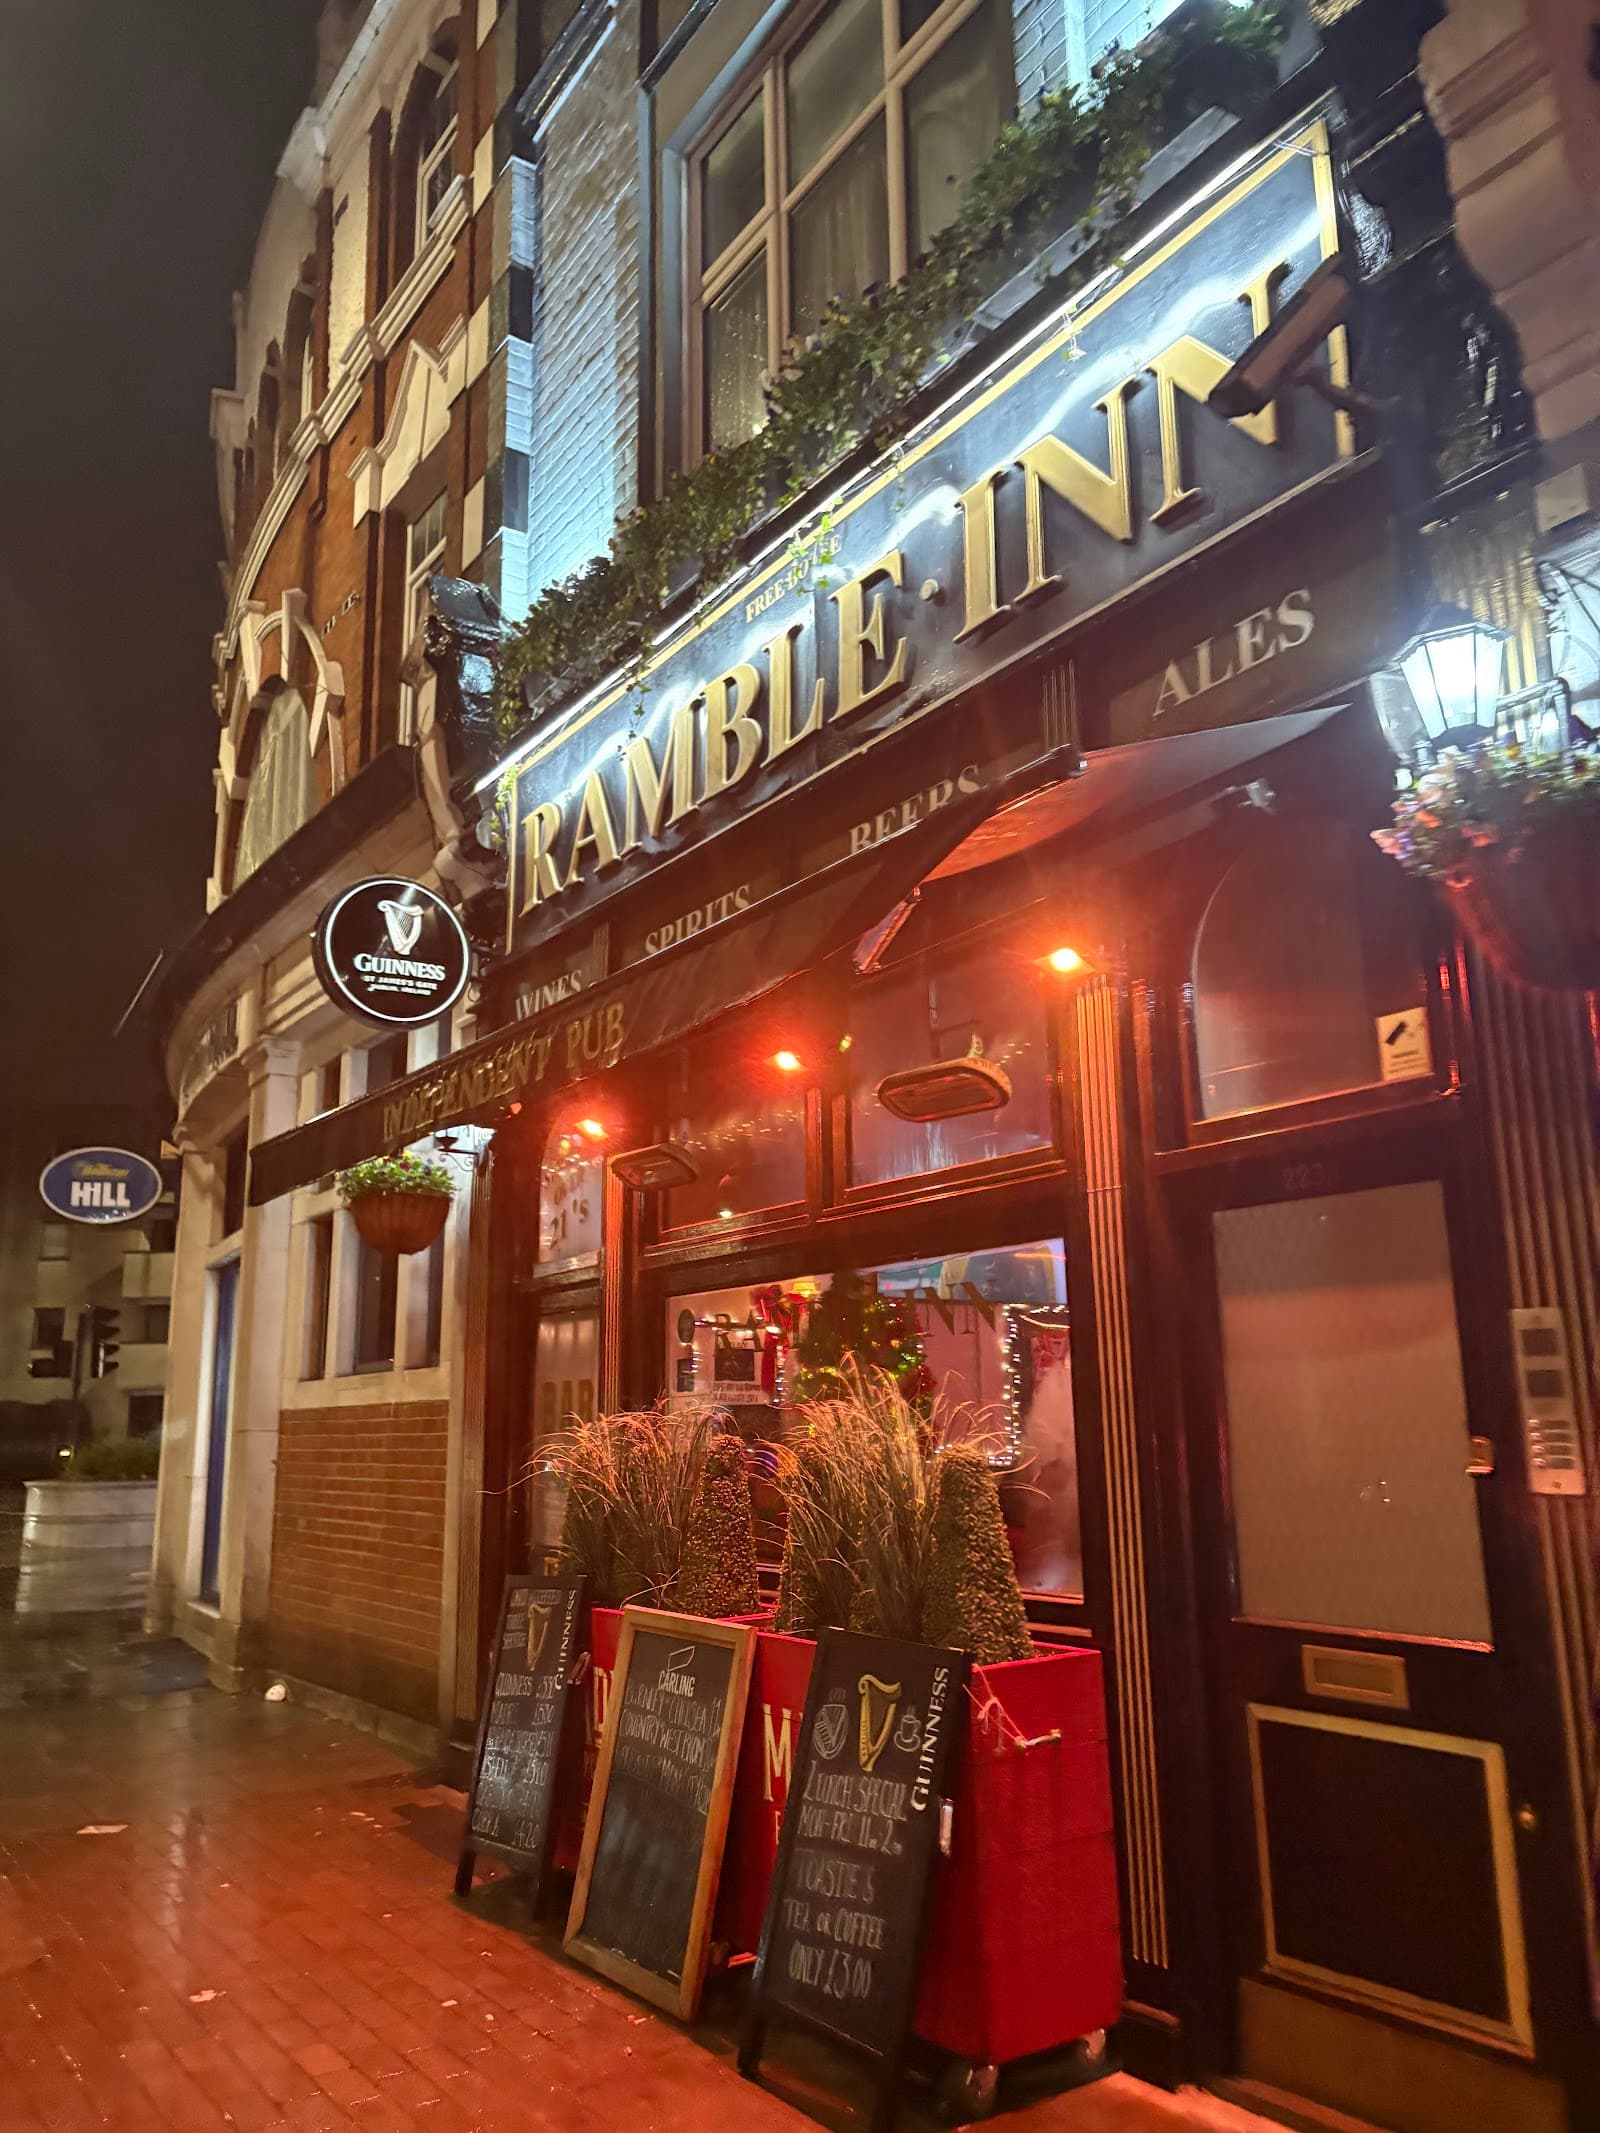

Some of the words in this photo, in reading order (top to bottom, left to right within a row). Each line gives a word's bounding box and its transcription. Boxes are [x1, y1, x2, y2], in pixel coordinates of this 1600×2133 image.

[519, 548, 907, 918] RAMBLE
[954, 260, 1291, 645] INN
[745, 578, 786, 624] FREE
[1152, 586, 1316, 720] ALES
[645, 884, 751, 955] SPIRITS
[353, 953, 446, 981] GUINNESS
[515, 967, 583, 1022] WINES
[566, 1001, 626, 1072] PUB
[71, 1181, 131, 1207] HILL
[658, 1669, 697, 1698] CARLING
[911, 1667, 949, 1811] GUINNESS
[834, 1907, 886, 1950] COFFEE
[789, 1940, 825, 1986] ONLY
